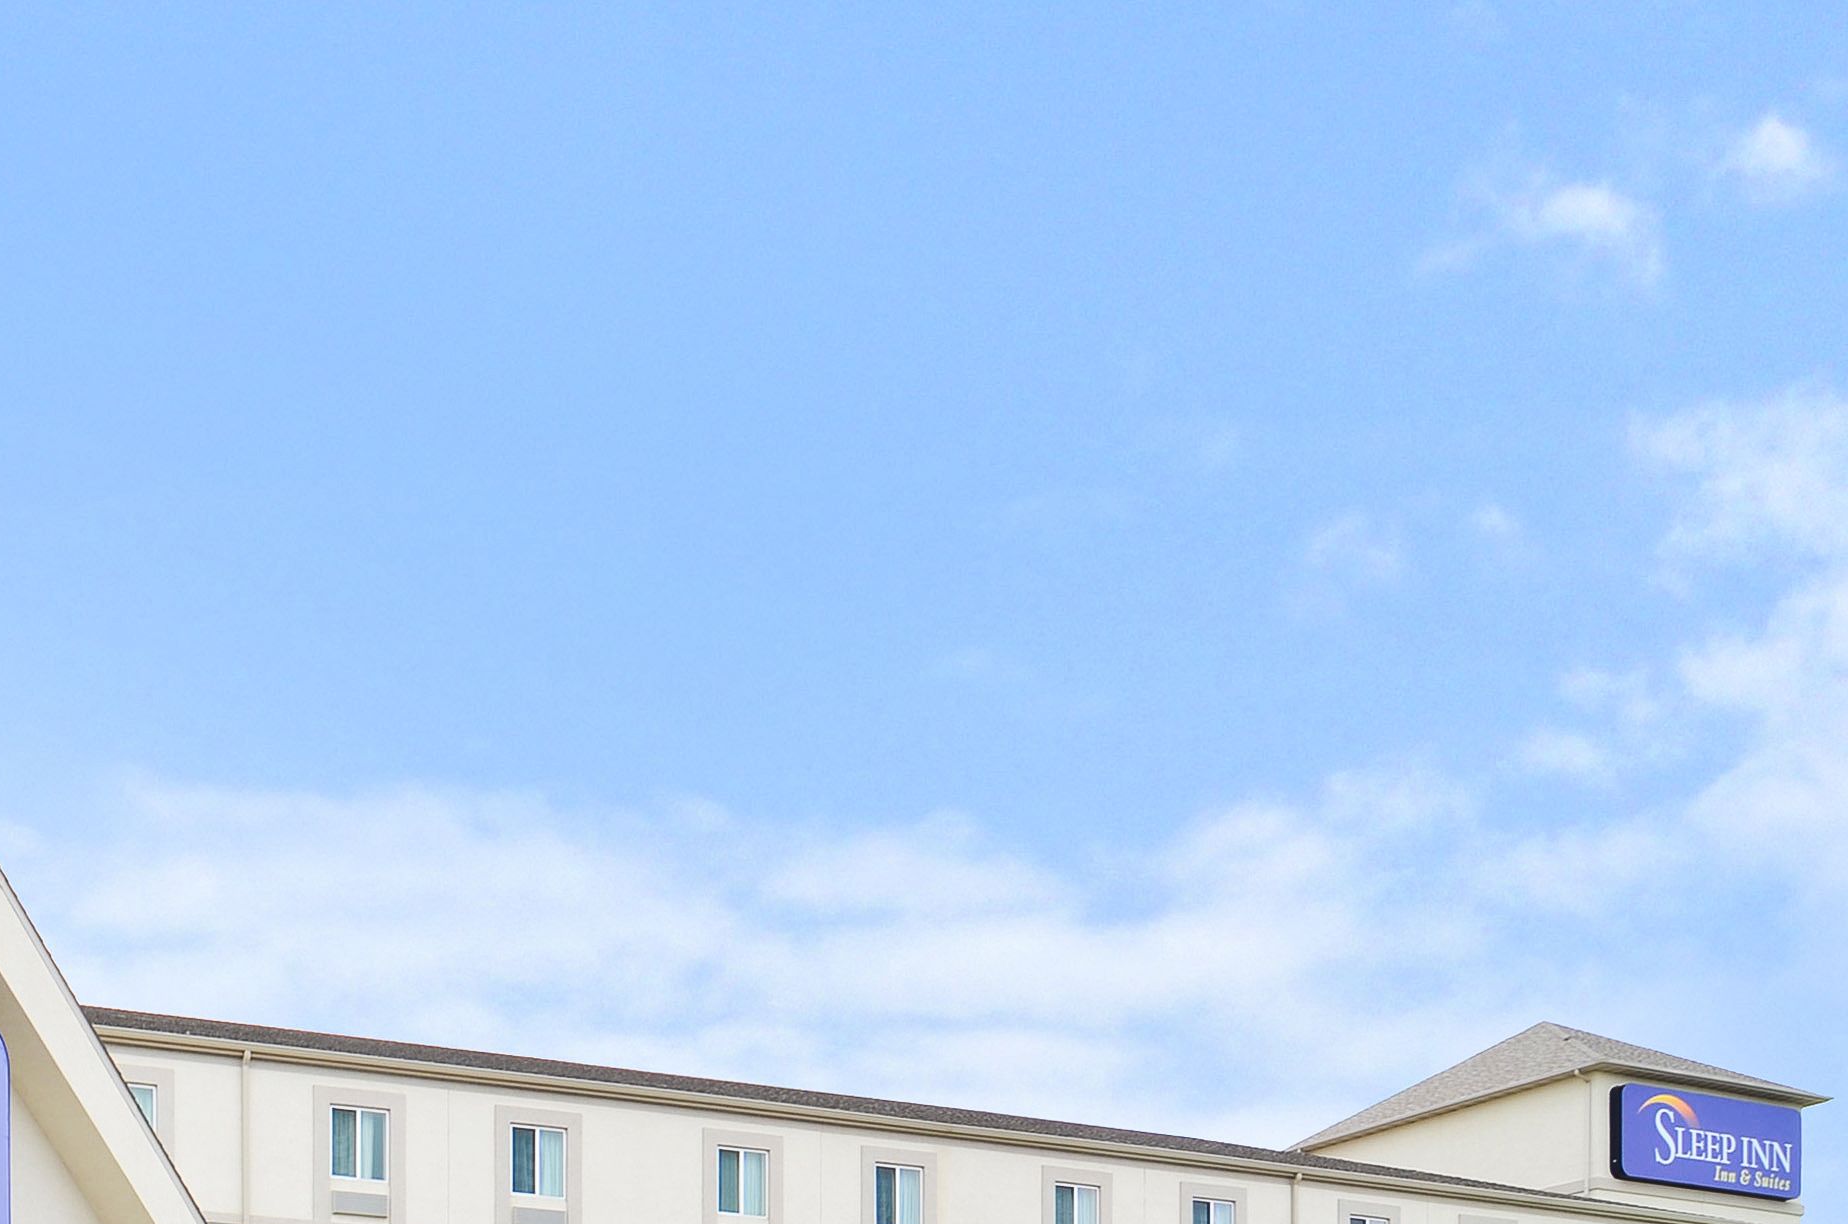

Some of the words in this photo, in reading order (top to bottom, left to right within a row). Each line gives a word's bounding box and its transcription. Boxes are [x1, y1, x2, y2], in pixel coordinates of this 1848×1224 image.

[1655, 1108, 1737, 1165] SLEEP
[1741, 1136, 1792, 1173] INN
[1714, 1166, 1736, 1183] Inn
[1740, 1169, 1751, 1186] &
[1754, 1172, 1791, 1191] Suites
